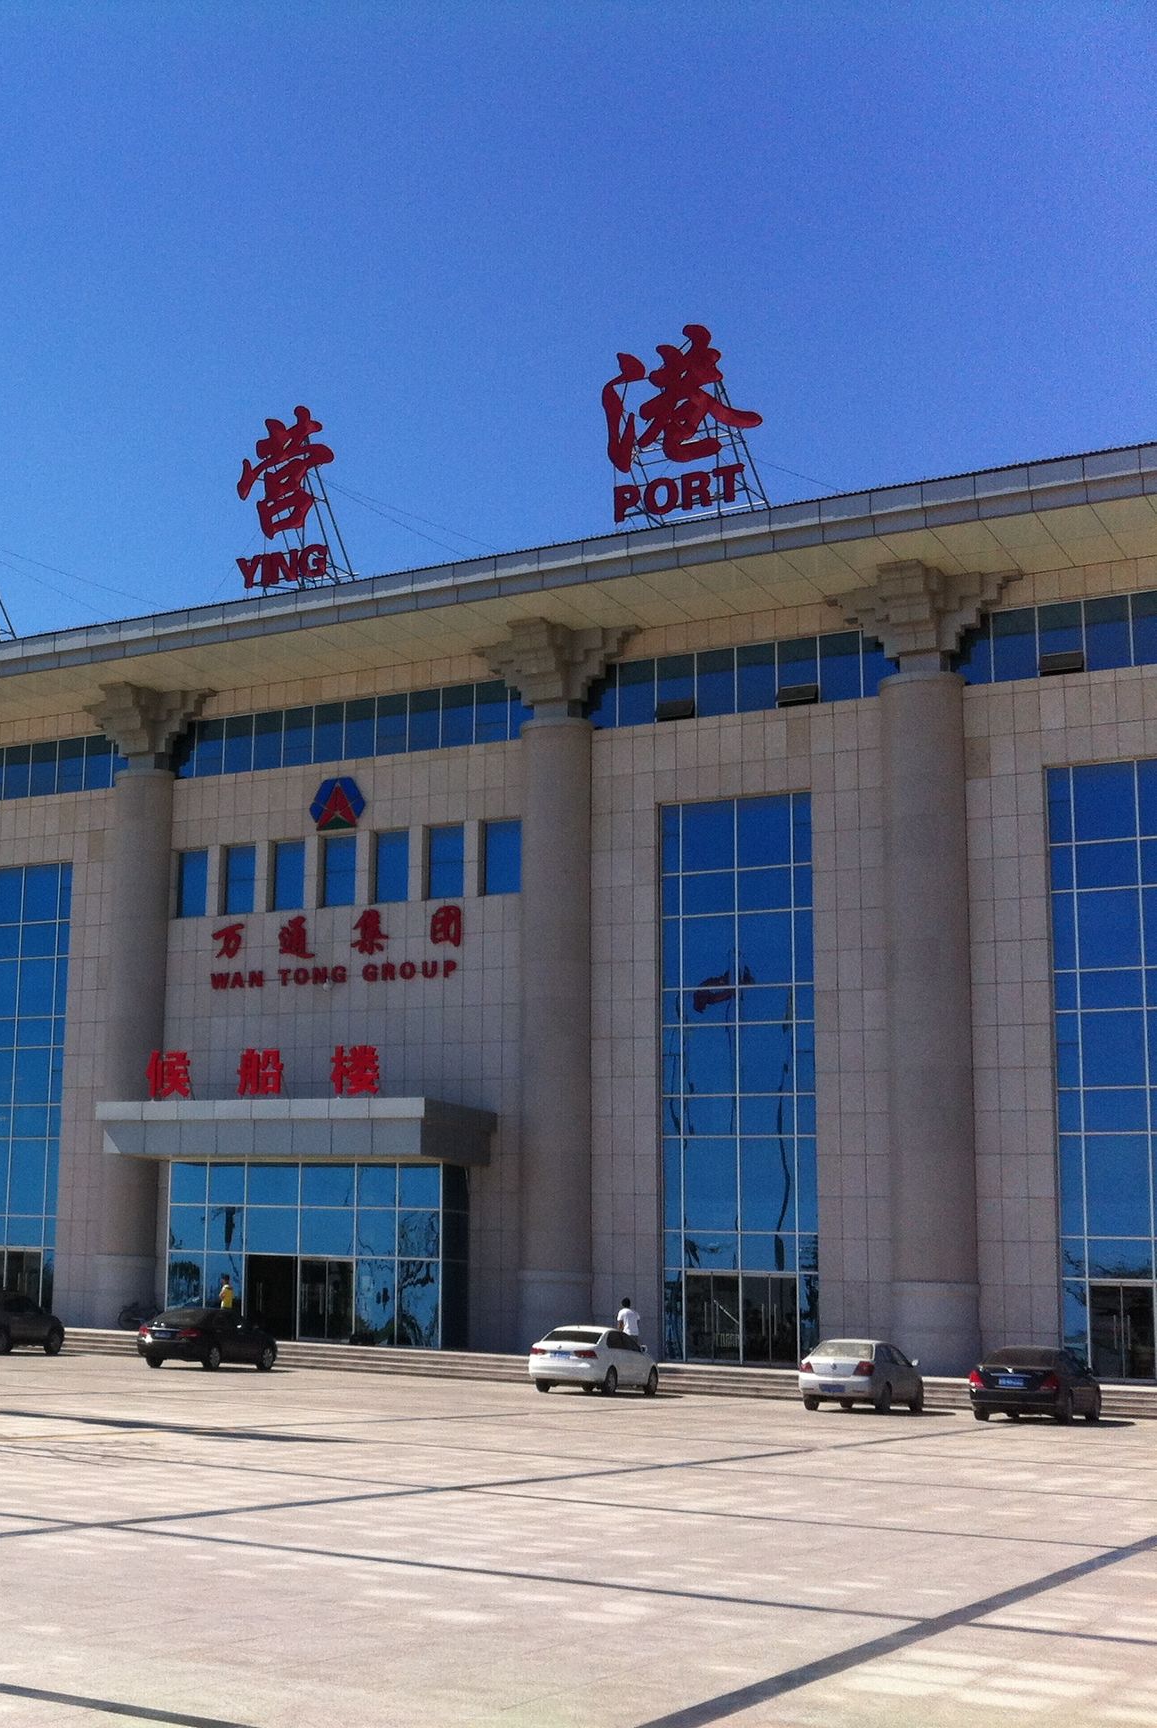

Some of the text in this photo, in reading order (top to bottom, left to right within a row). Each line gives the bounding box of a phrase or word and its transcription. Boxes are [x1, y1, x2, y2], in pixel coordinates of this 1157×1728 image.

[237, 405, 334, 540] 营
[601, 324, 763, 474] 港
[236, 544, 329, 590] YING
[613, 463, 746, 523] PORT
[212, 904, 463, 960] 万通集团
[210, 960, 458, 990] WAN TONG GROUP
[145, 1045, 380, 1098] 候船楼
